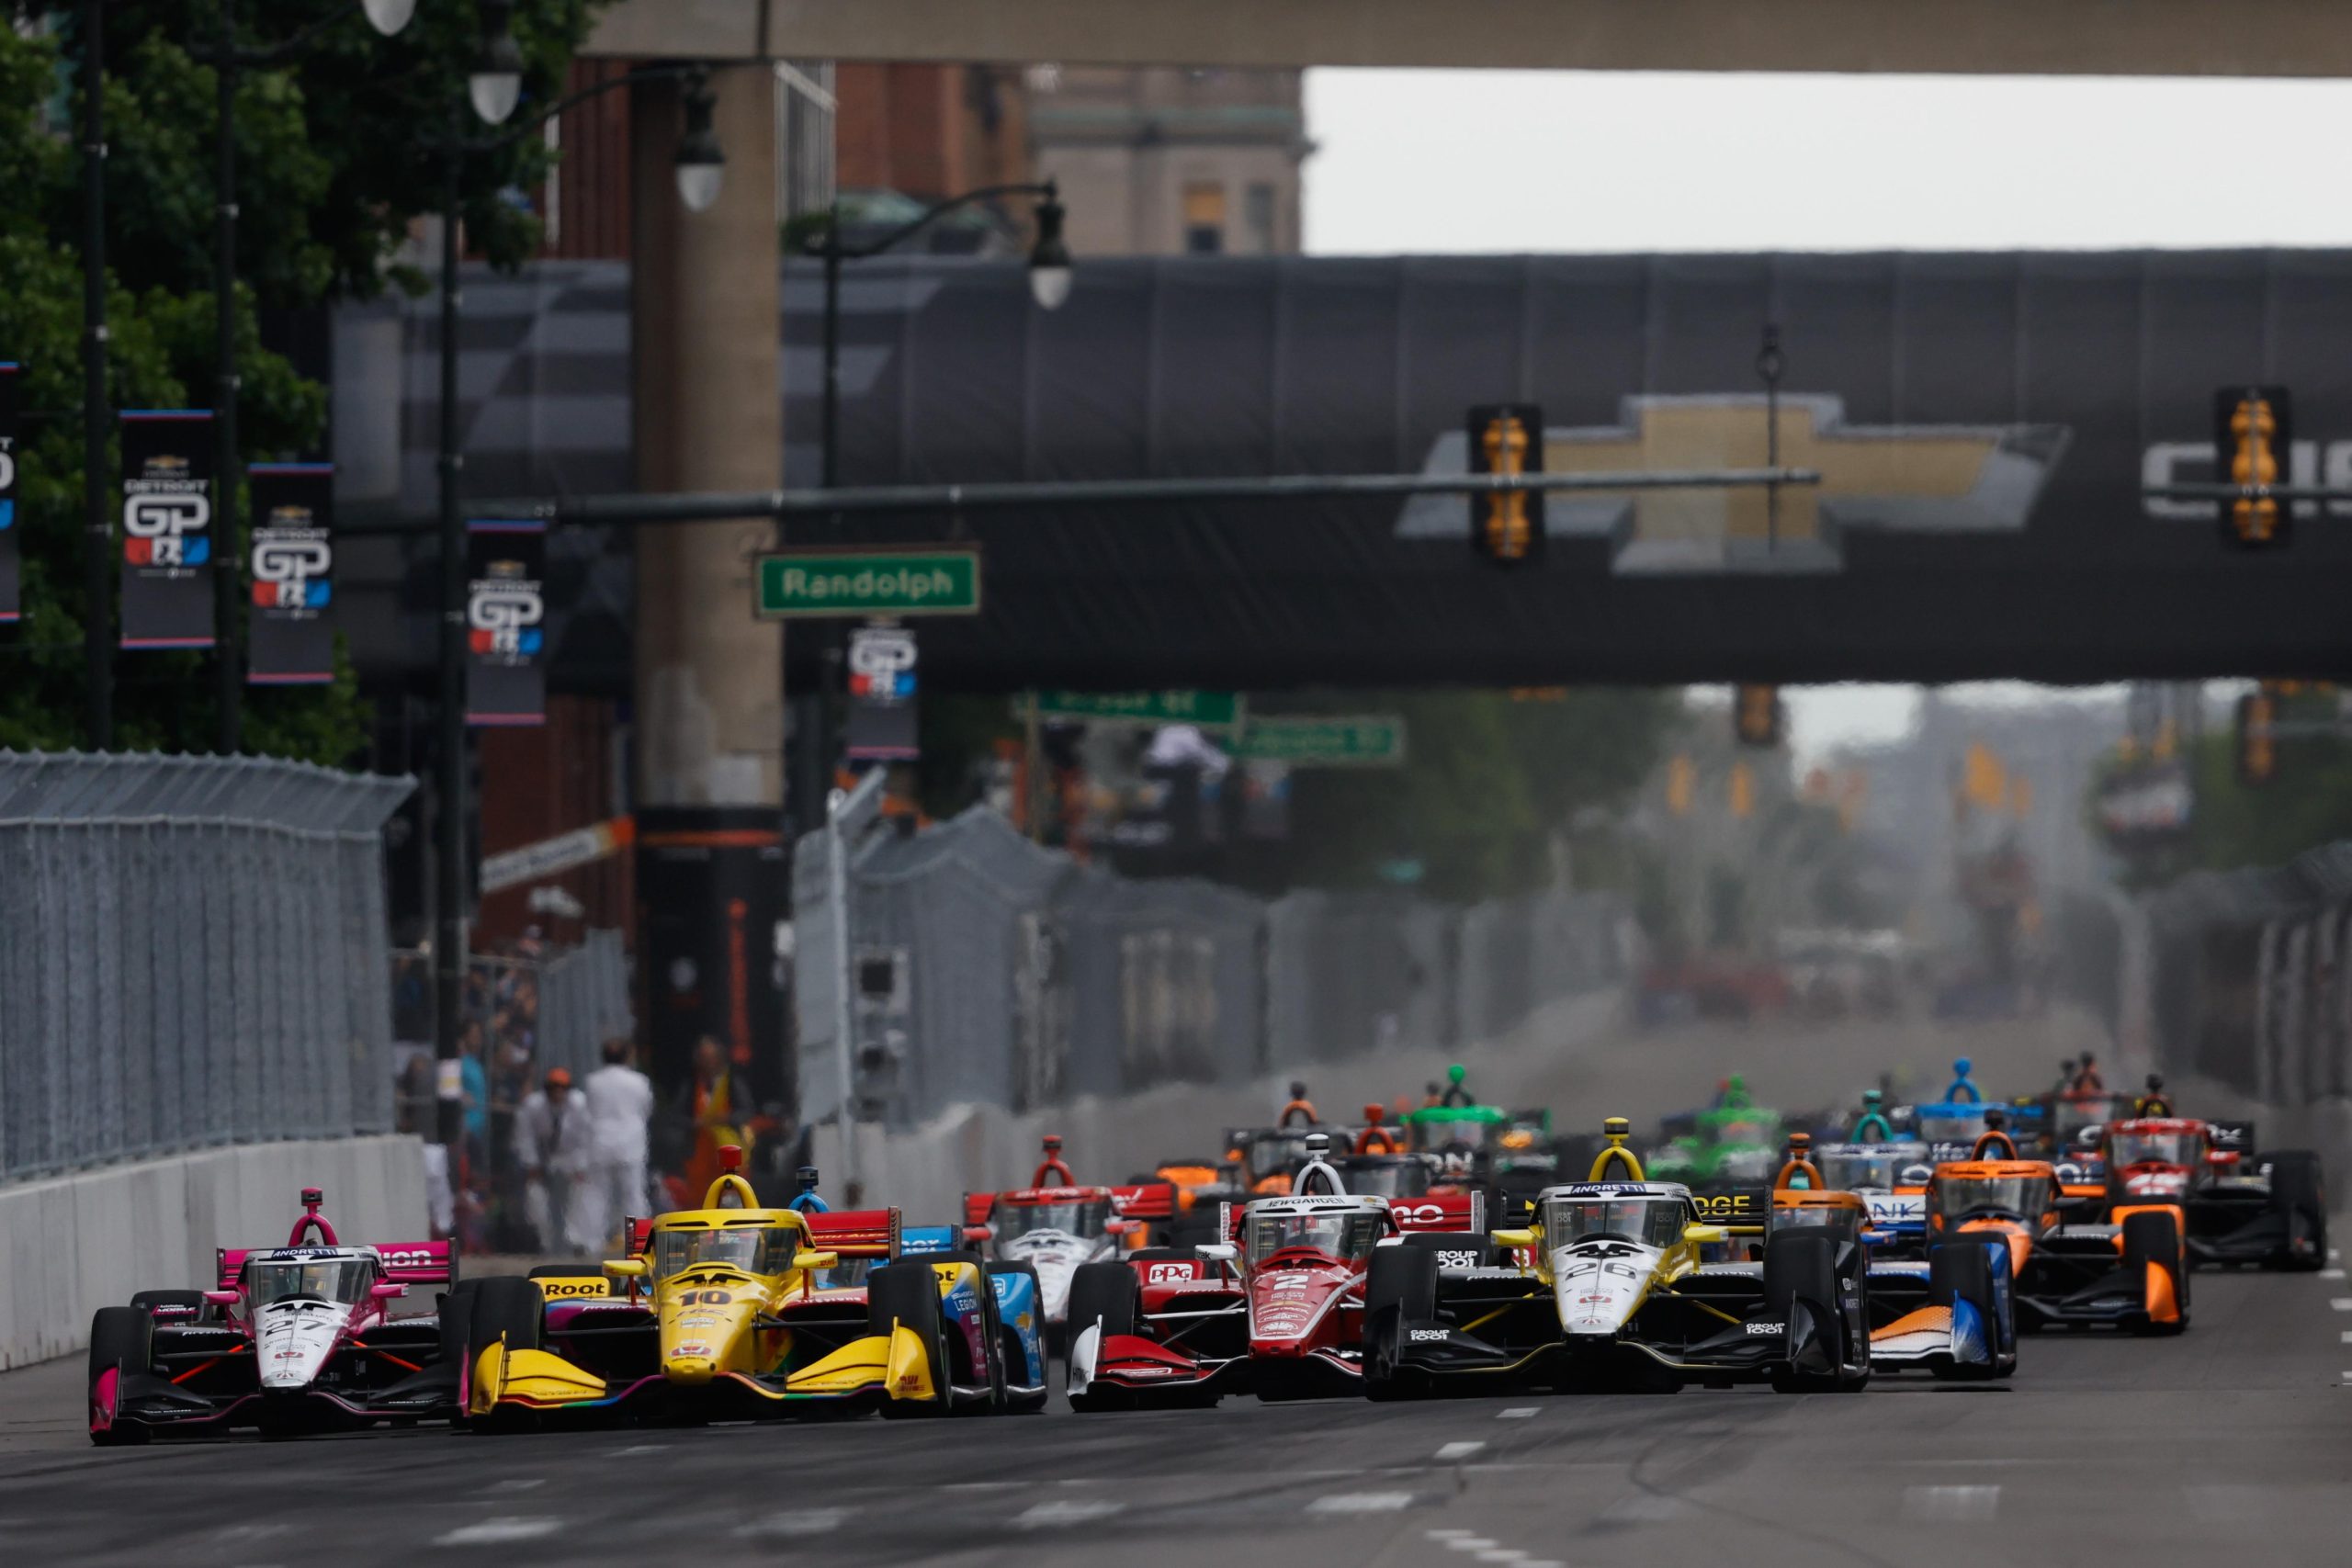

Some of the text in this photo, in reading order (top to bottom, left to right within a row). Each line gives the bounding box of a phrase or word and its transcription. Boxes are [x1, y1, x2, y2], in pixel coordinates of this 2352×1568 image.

[124, 479, 209, 493] DETROIT
[124, 494, 209, 536] GP
[252, 539, 331, 582] GP
[783, 567, 953, 601] Randolph
[468, 591, 544, 628] GP
[1572, 1184, 1643, 1194] ANDRETTI
[1266, 1196, 1345, 1209] NEWGARDEN
[1692, 1195, 1750, 1216] DGE
[273, 1248, 337, 1258] ANDRETTI
[1152, 1266, 1191, 1282] PPG
[1565, 1262, 1637, 1280] 26
[545, 1283, 605, 1296] Root
[1273, 1275, 1309, 1291] 2
[679, 1291, 732, 1307] 10
[955, 1296, 978, 1312] LEGION
[265, 1318, 328, 1337] 27
